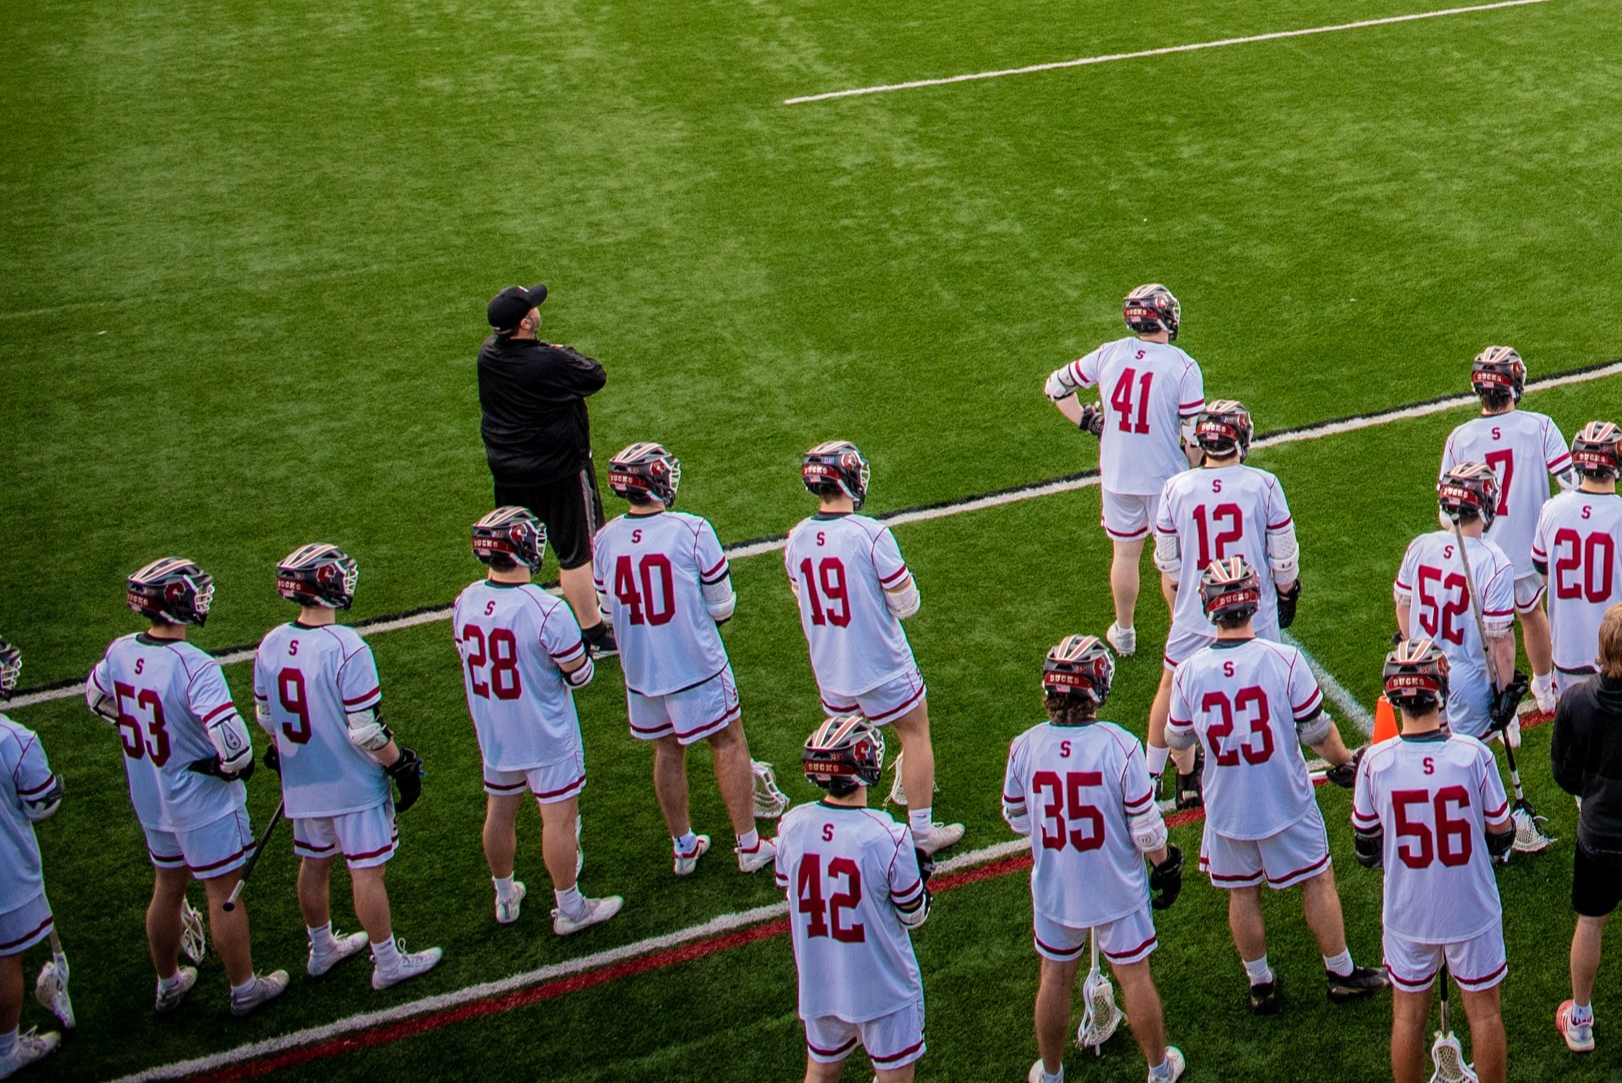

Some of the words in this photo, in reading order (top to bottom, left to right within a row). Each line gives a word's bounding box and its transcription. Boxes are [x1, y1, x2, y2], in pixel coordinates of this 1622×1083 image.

[1136, 350, 1146, 360] S
[1111, 367, 1154, 434] 41
[1492, 427, 1501, 440] S
[1212, 479, 1222, 493] S
[1485, 449, 1514, 516] 7
[1581, 505, 1592, 519] S
[631, 529, 642, 543] S
[816, 532, 825, 546] S
[1193, 503, 1244, 570] 12
[1443, 545, 1454, 559] S
[1555, 528, 1615, 603] 20
[614, 553, 676, 626] 40
[800, 557, 851, 628] 19
[1220, 592, 1249, 605] DUCKS
[484, 600, 495, 616] S
[1418, 565, 1470, 645] 52
[288, 640, 299, 656] S
[134, 658, 144, 675] S
[463, 624, 522, 700] 28
[1223, 661, 1234, 677] S
[1050, 674, 1080, 684] DUCKS
[1393, 677, 1424, 686] DUCKS
[278, 667, 312, 745] 9
[114, 680, 171, 768] 53
[1202, 685, 1275, 766] 23
[1060, 740, 1071, 758] S
[808, 763, 839, 772] DUCKS
[1422, 757, 1434, 775] S
[1032, 771, 1105, 852] 35
[821, 824, 834, 842] S
[1391, 785, 1472, 868] 56
[798, 853, 865, 943] 42
